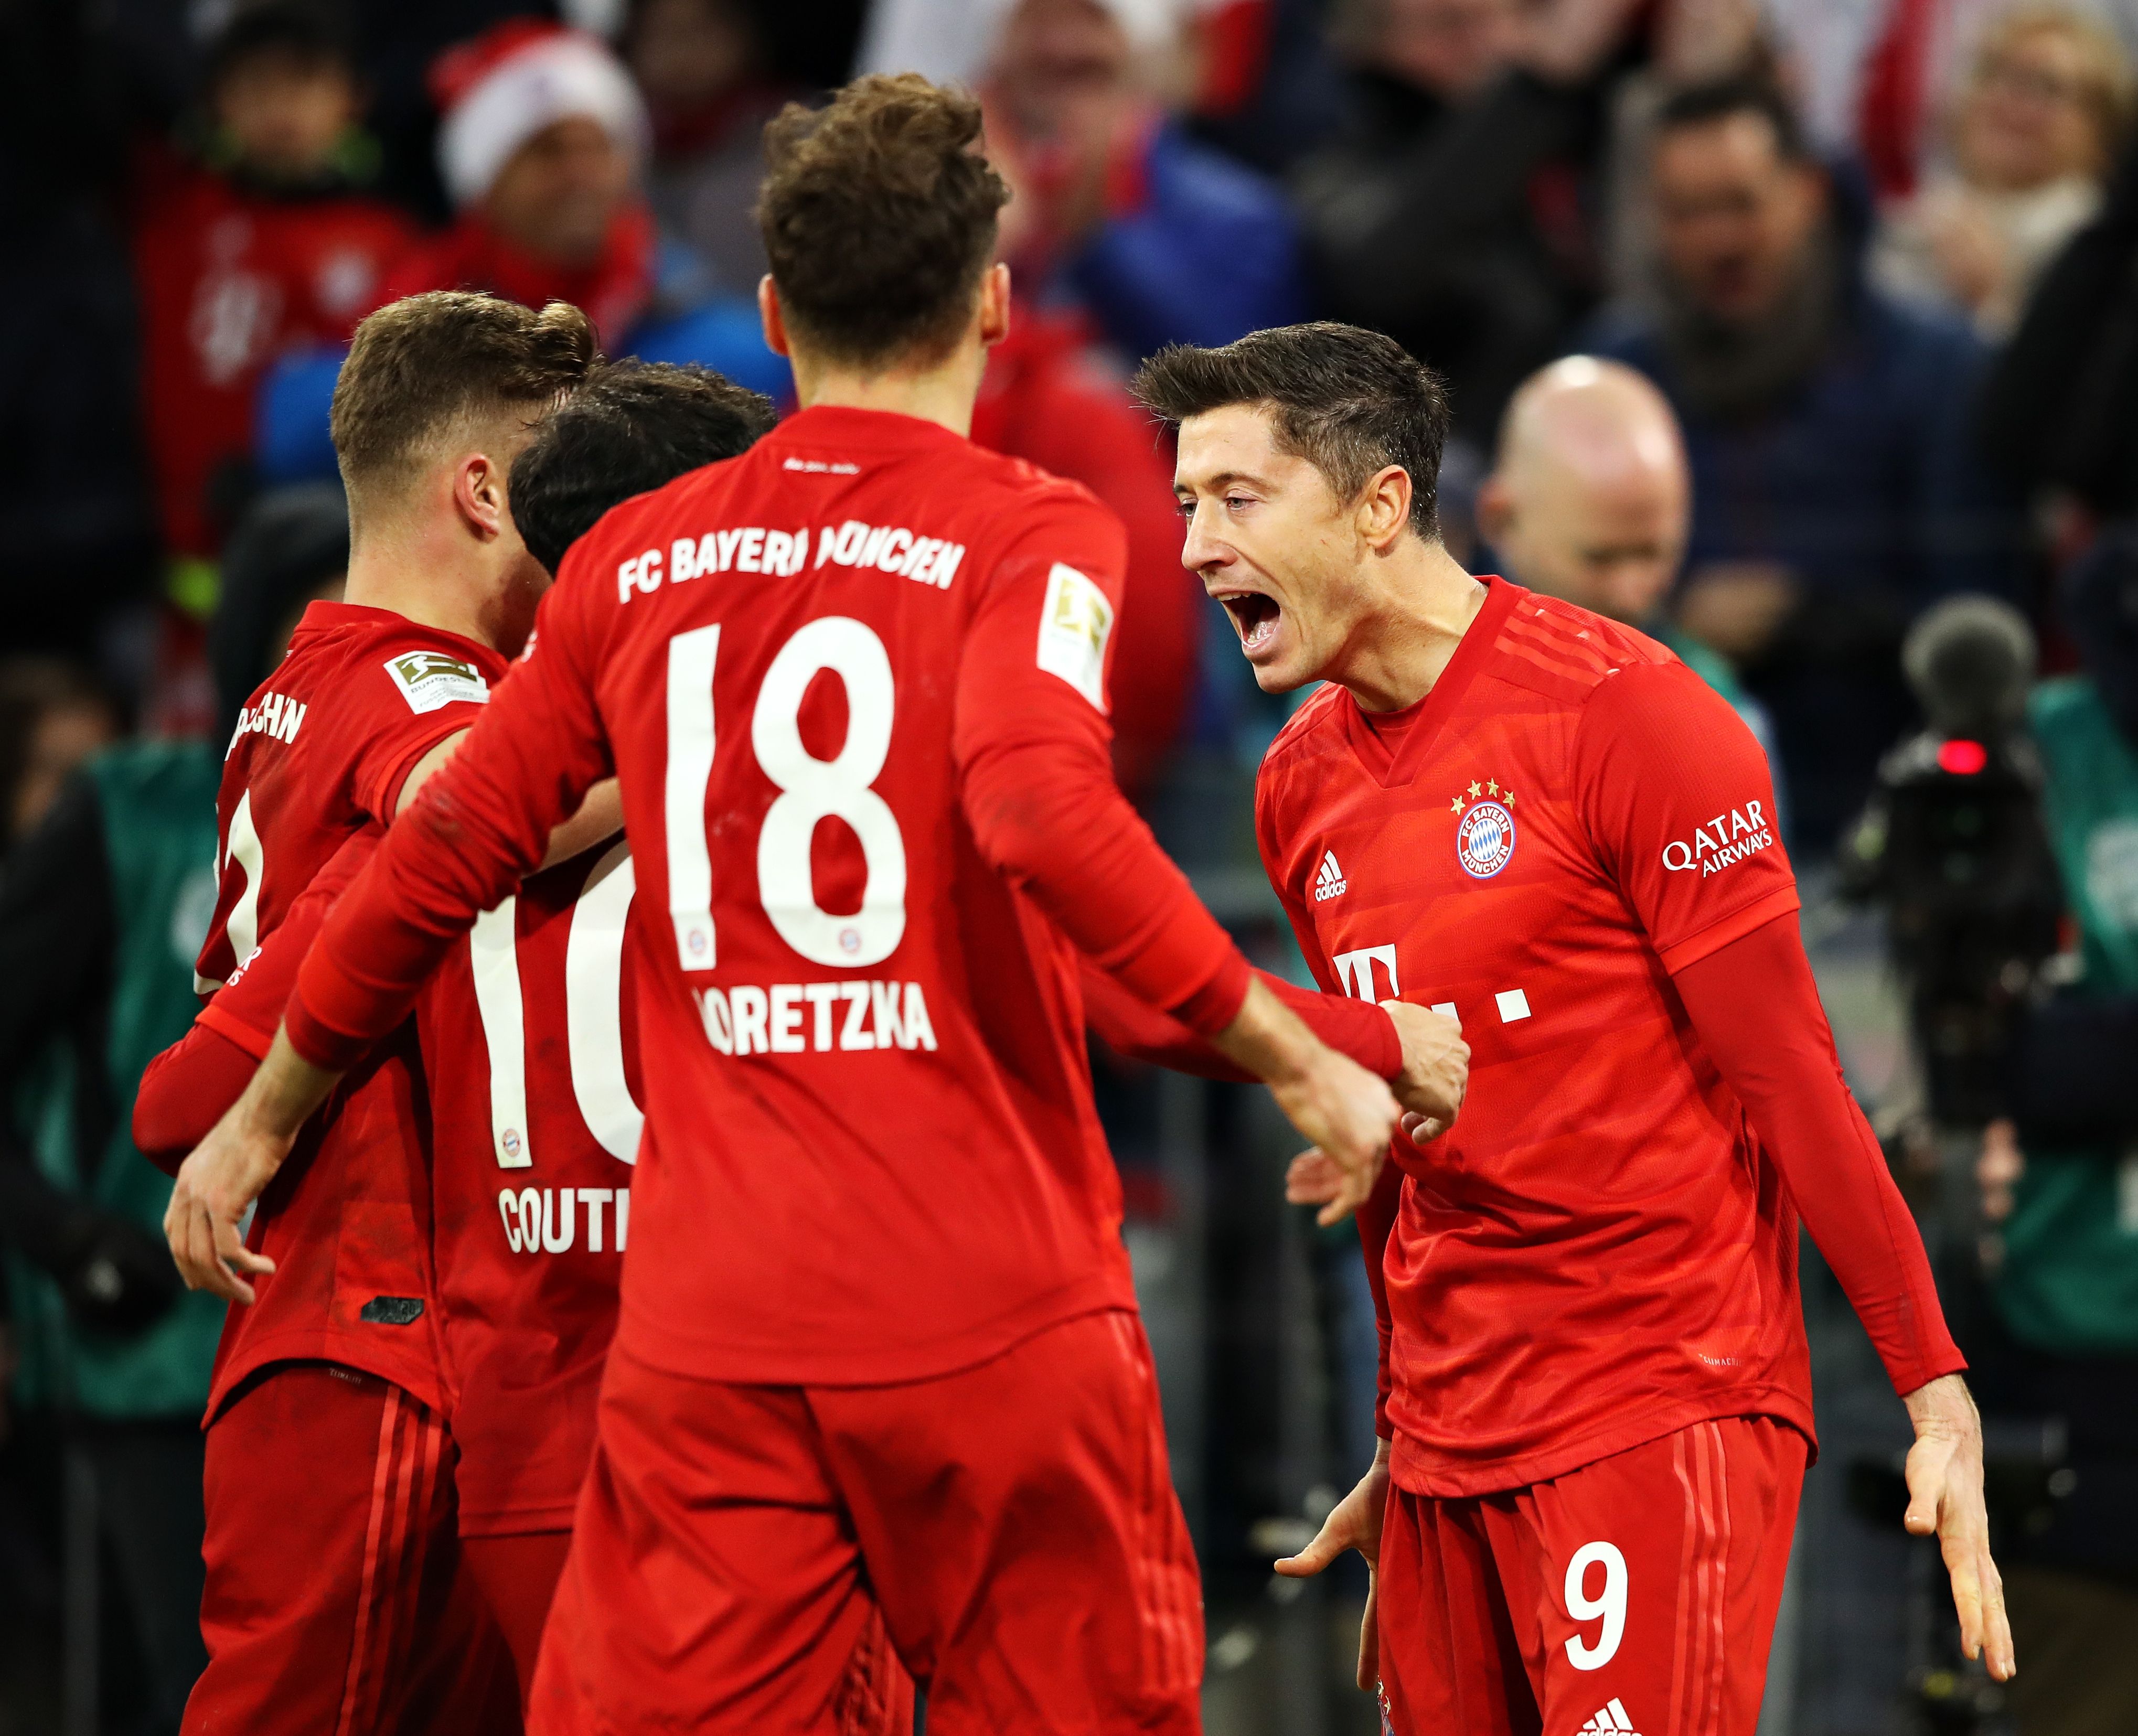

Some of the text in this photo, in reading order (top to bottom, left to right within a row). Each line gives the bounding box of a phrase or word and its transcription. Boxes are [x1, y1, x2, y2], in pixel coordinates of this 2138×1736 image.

[617, 549, 663, 605] FC
[665, 616, 907, 971] 18
[1462, 807, 1510, 838] FC BAYERN
[1662, 800, 1767, 871] QATAR
[1703, 828, 1772, 878] AIRWAYS
[1315, 879, 1346, 902] adidas
[691, 980, 938, 1056] ORETZKA
[1564, 1540, 1629, 1671] 9
